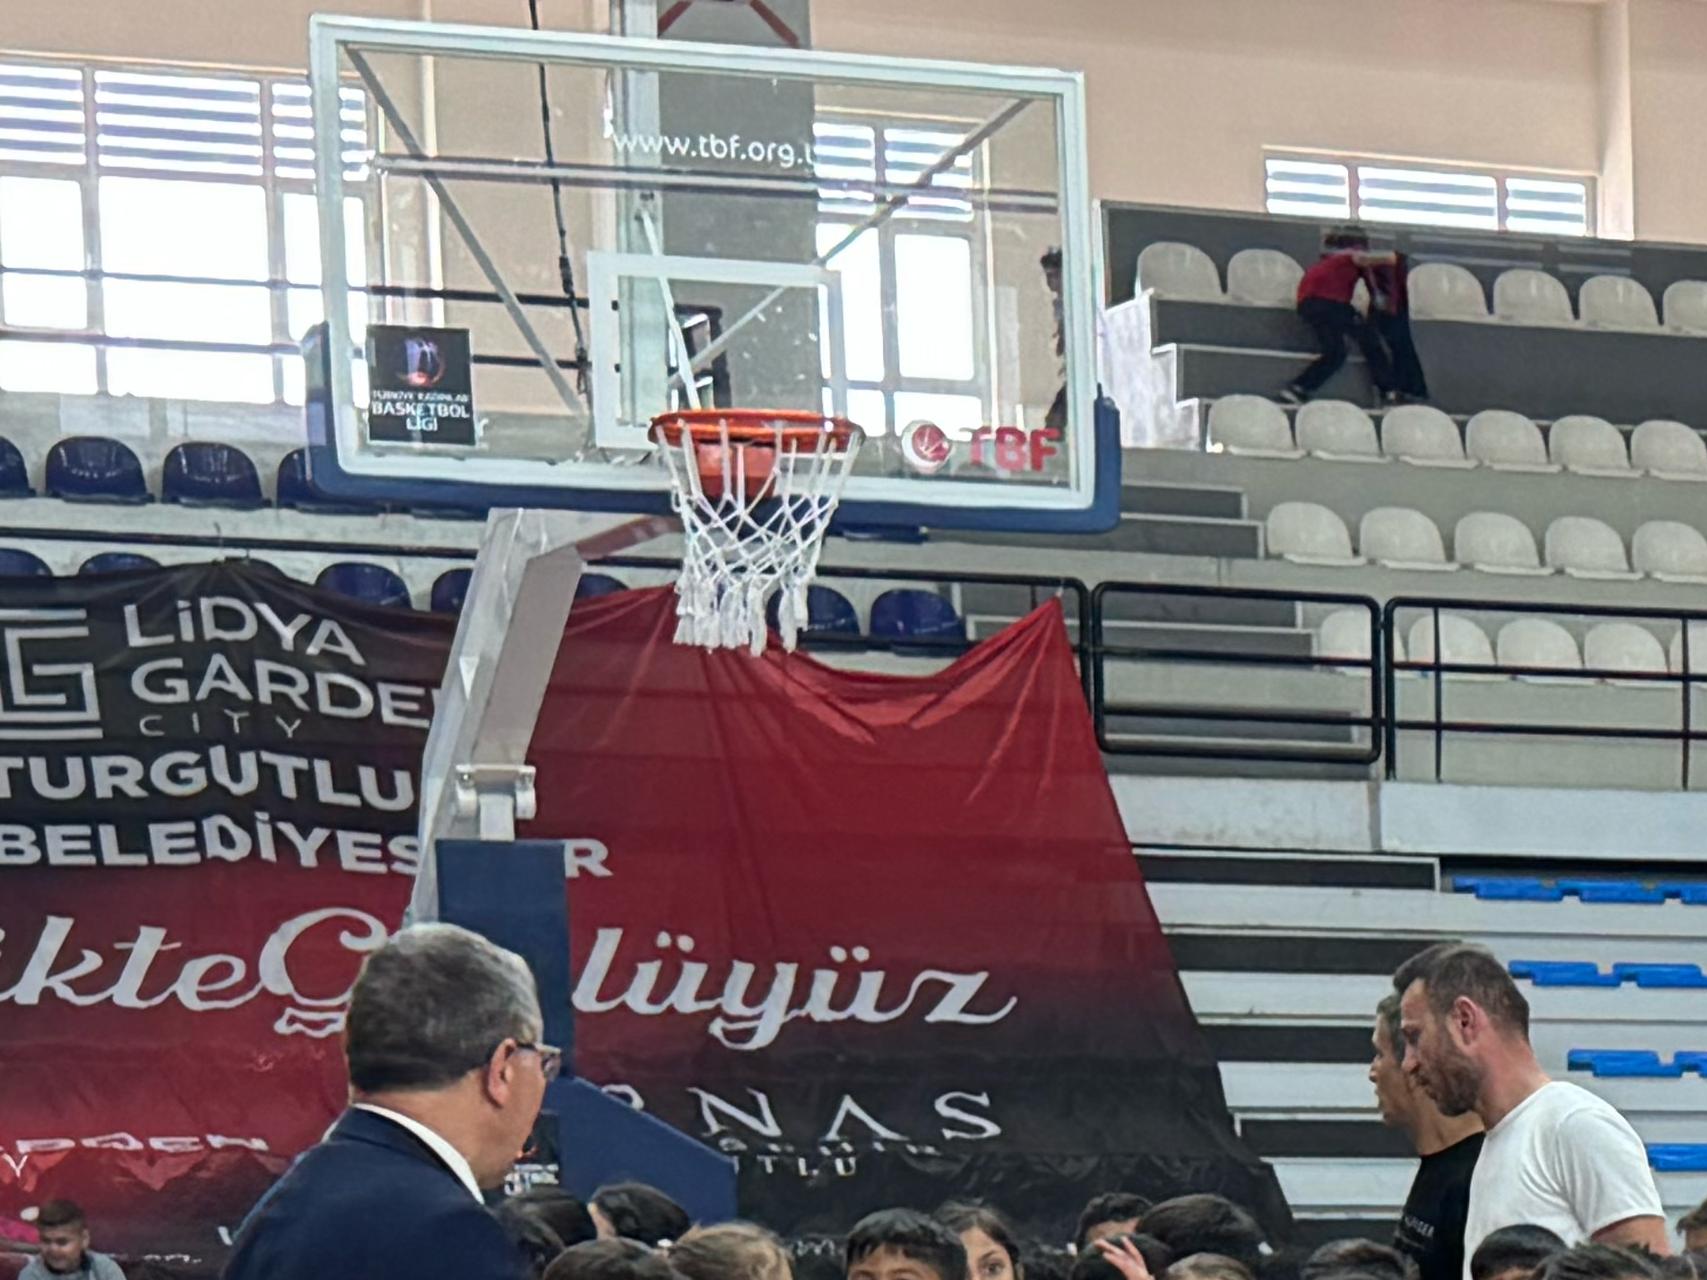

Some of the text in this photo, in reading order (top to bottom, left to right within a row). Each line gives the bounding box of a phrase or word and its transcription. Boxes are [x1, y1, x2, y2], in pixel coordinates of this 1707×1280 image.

[371, 401, 471, 419] BASKETBOL
[130, 652, 442, 730] GARDE
[139, 711, 302, 739] CITY
